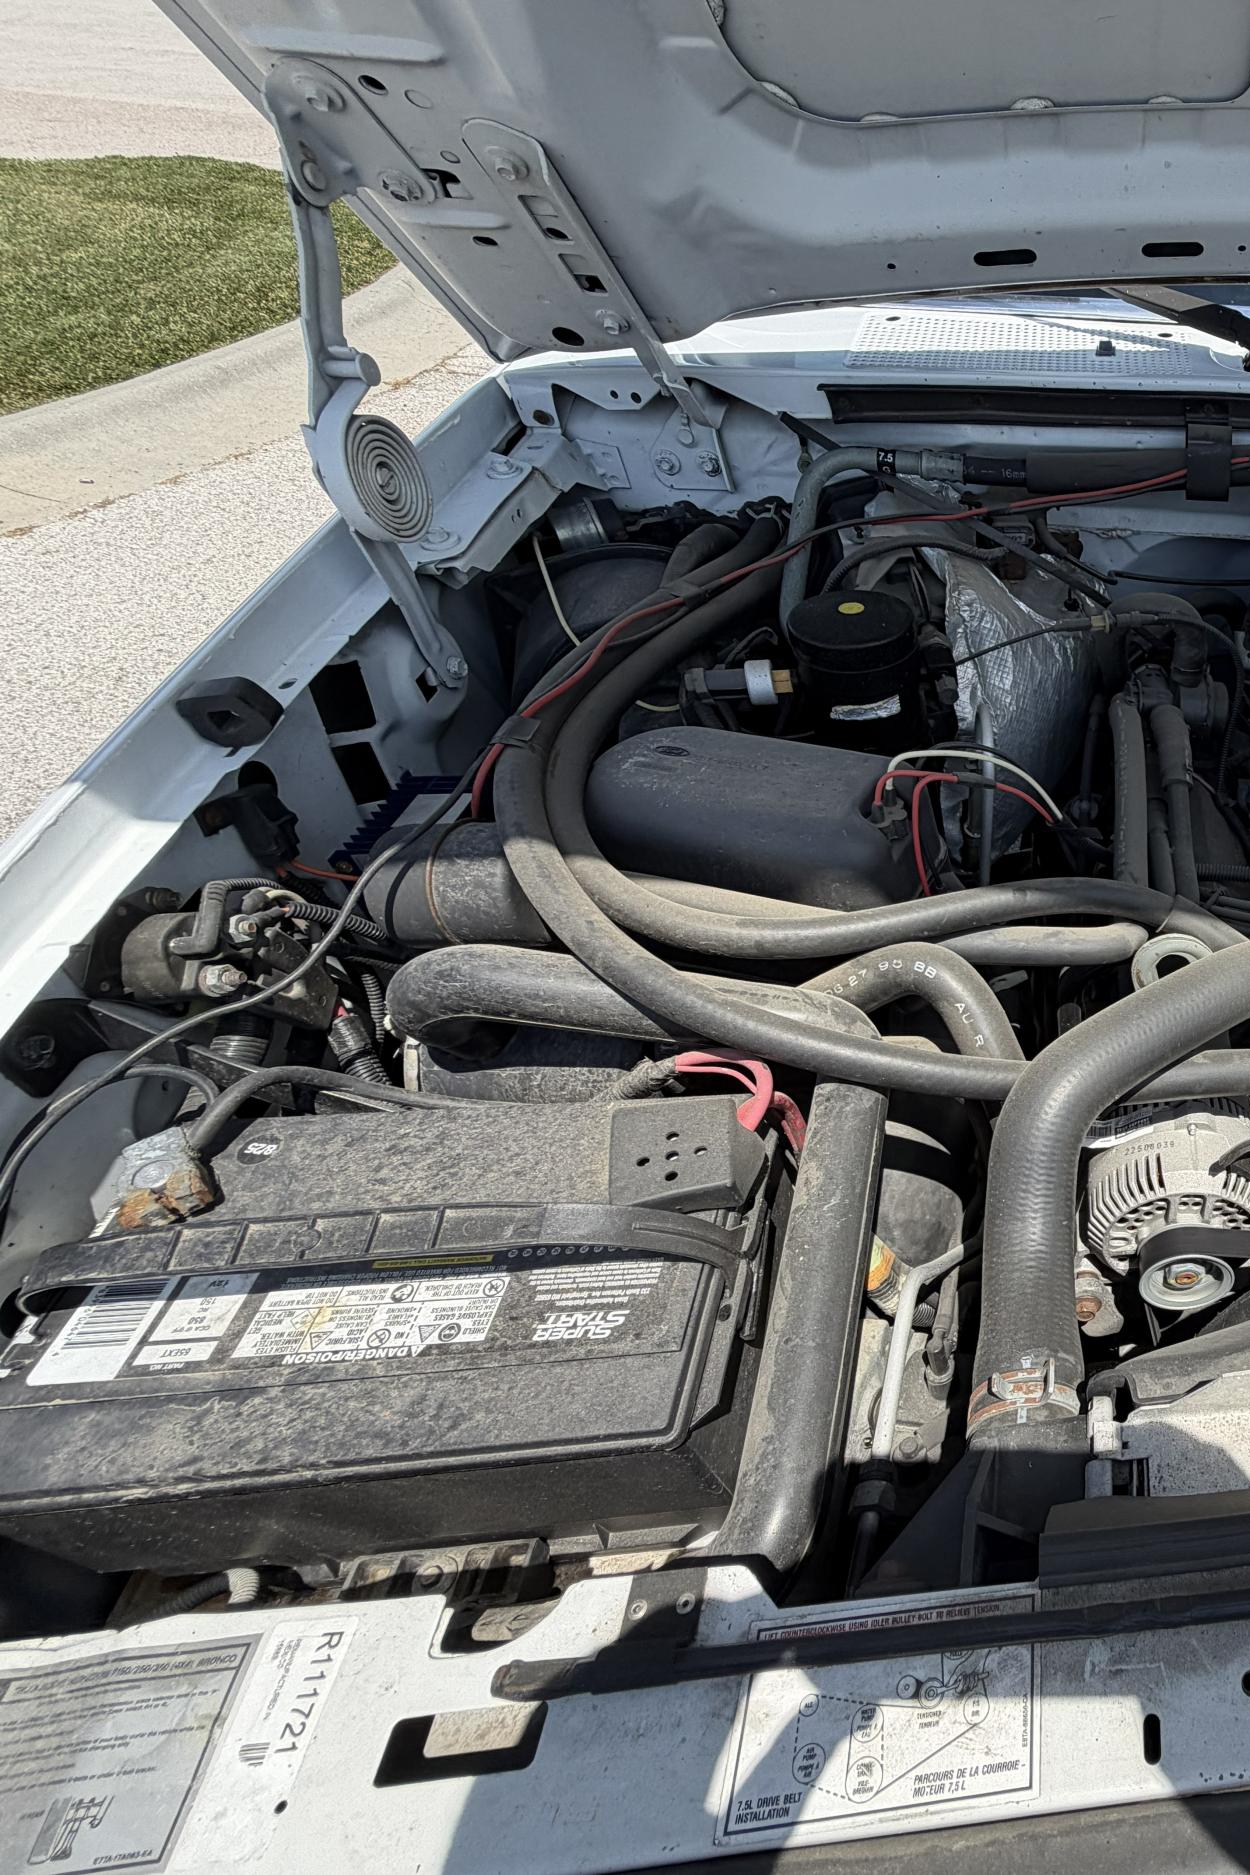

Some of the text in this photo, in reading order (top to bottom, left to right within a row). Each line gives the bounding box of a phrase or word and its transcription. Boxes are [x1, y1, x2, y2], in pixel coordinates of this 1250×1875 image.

[879, 452, 894, 463] 7.5
[848, 969, 868, 987] 27
[955, 1002, 975, 1024] AU
[244, 1142, 278, 1155] 8/25
[207, 1280, 229, 1289] 12V
[199, 1297, 217, 1306] 150
[187, 1316, 206, 1325] 850
[433, 1312, 493, 1322] EXPLOSIVE GASES
[537, 1310, 630, 1328] START
[253, 1319, 283, 1328] MEDICAL
[335, 1322, 354, 1330] CAUSE
[288, 1331, 306, 1339] WITH
[346, 1329, 364, 1337] ACID
[462, 1328, 487, 1336] SHIELD
[532, 1325, 614, 1341] SUPER
[252, 1338, 302, 1348] IMMEDIATELY
[325, 1336, 360, 1346] SULFURIC
[160, 1347, 192, 1358] 65EXT
[254, 1346, 297, 1356] FLUSH EYES
[281, 1346, 408, 1365] DANGER/POISON
[164, 1362, 185, 1370] PART
[849, 1620, 869, 1634] USING
[870, 1617, 890, 1631] IDLER
[918, 1611, 933, 1625] BOLT
[936, 1610, 944, 1623] TO
[946, 1607, 971, 1622] RELIEVE
[972, 1603, 1000, 1619] TENSION
[196, 1654, 237, 1668] BRONCO
[274, 1631, 345, 1754] R111721
[913, 1759, 1020, 1786] PARCOURS DE LA COURROIE
[947, 1781, 959, 1795] 7,5
[960, 1780, 966, 1791] L
[737, 1791, 803, 1812] 7.5L DRIVE BELT
[734, 1806, 791, 1825] INSTALLATION
